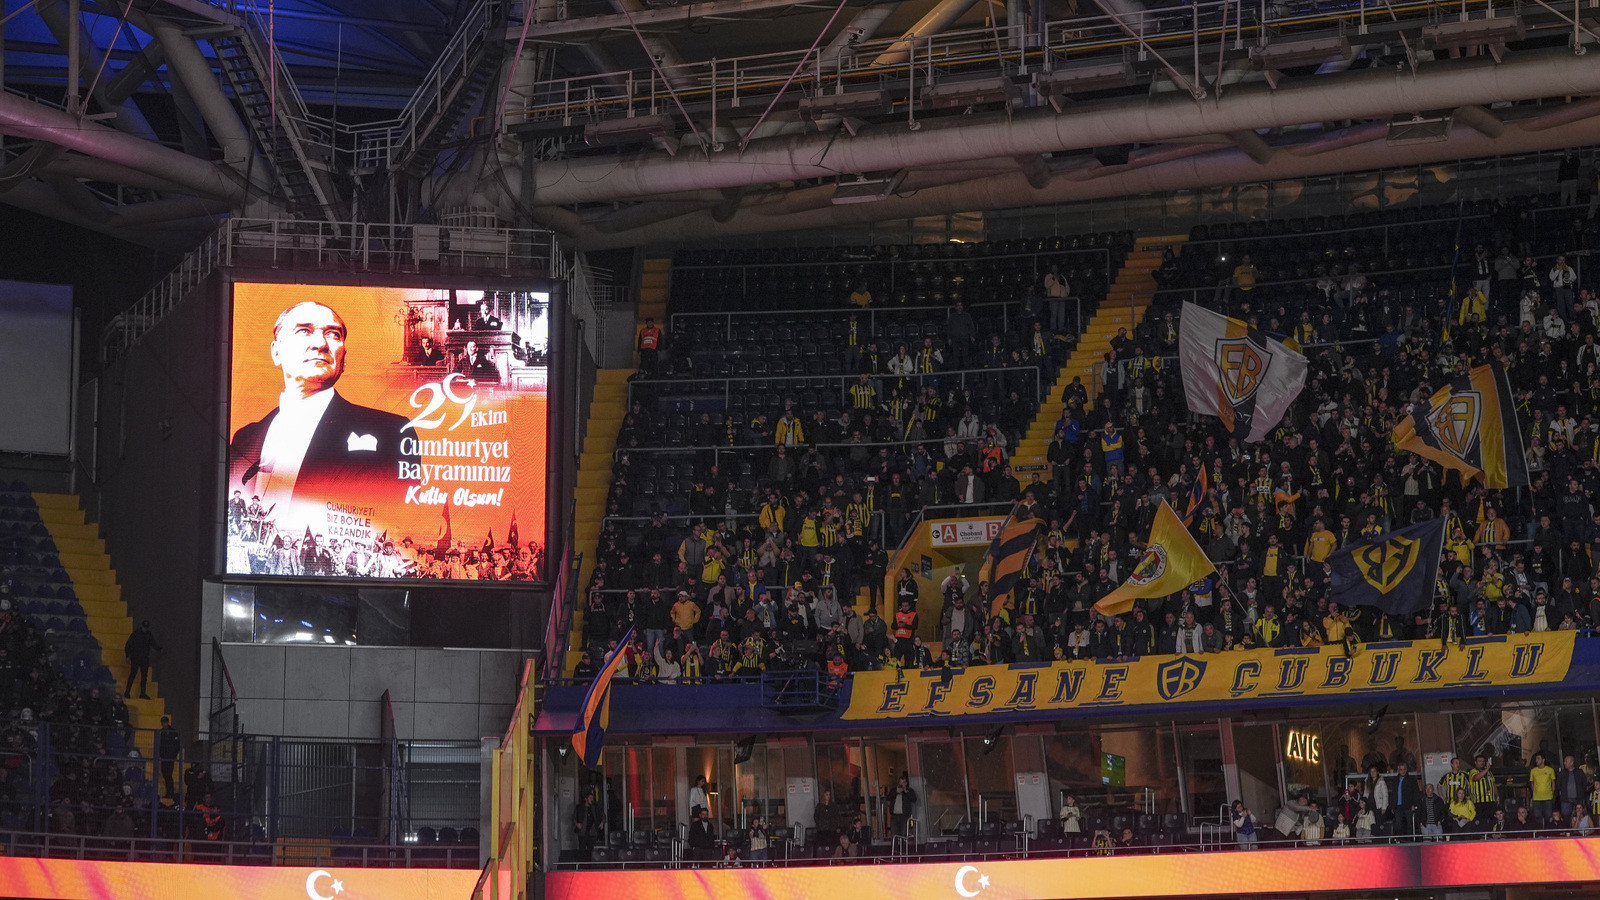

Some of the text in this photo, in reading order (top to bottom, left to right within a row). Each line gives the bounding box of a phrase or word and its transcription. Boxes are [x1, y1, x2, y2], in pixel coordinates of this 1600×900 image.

[399, 436, 510, 464] Cumhuriyet
[397, 460, 511, 486] Bayramımız
[404, 485, 504, 507] Kutlu Olsun!
[943, 525, 955, 539] A
[989, 523, 999, 537] B
[876, 665, 1130, 714] EFSANE
[1287, 729, 1321, 764] AVIS
